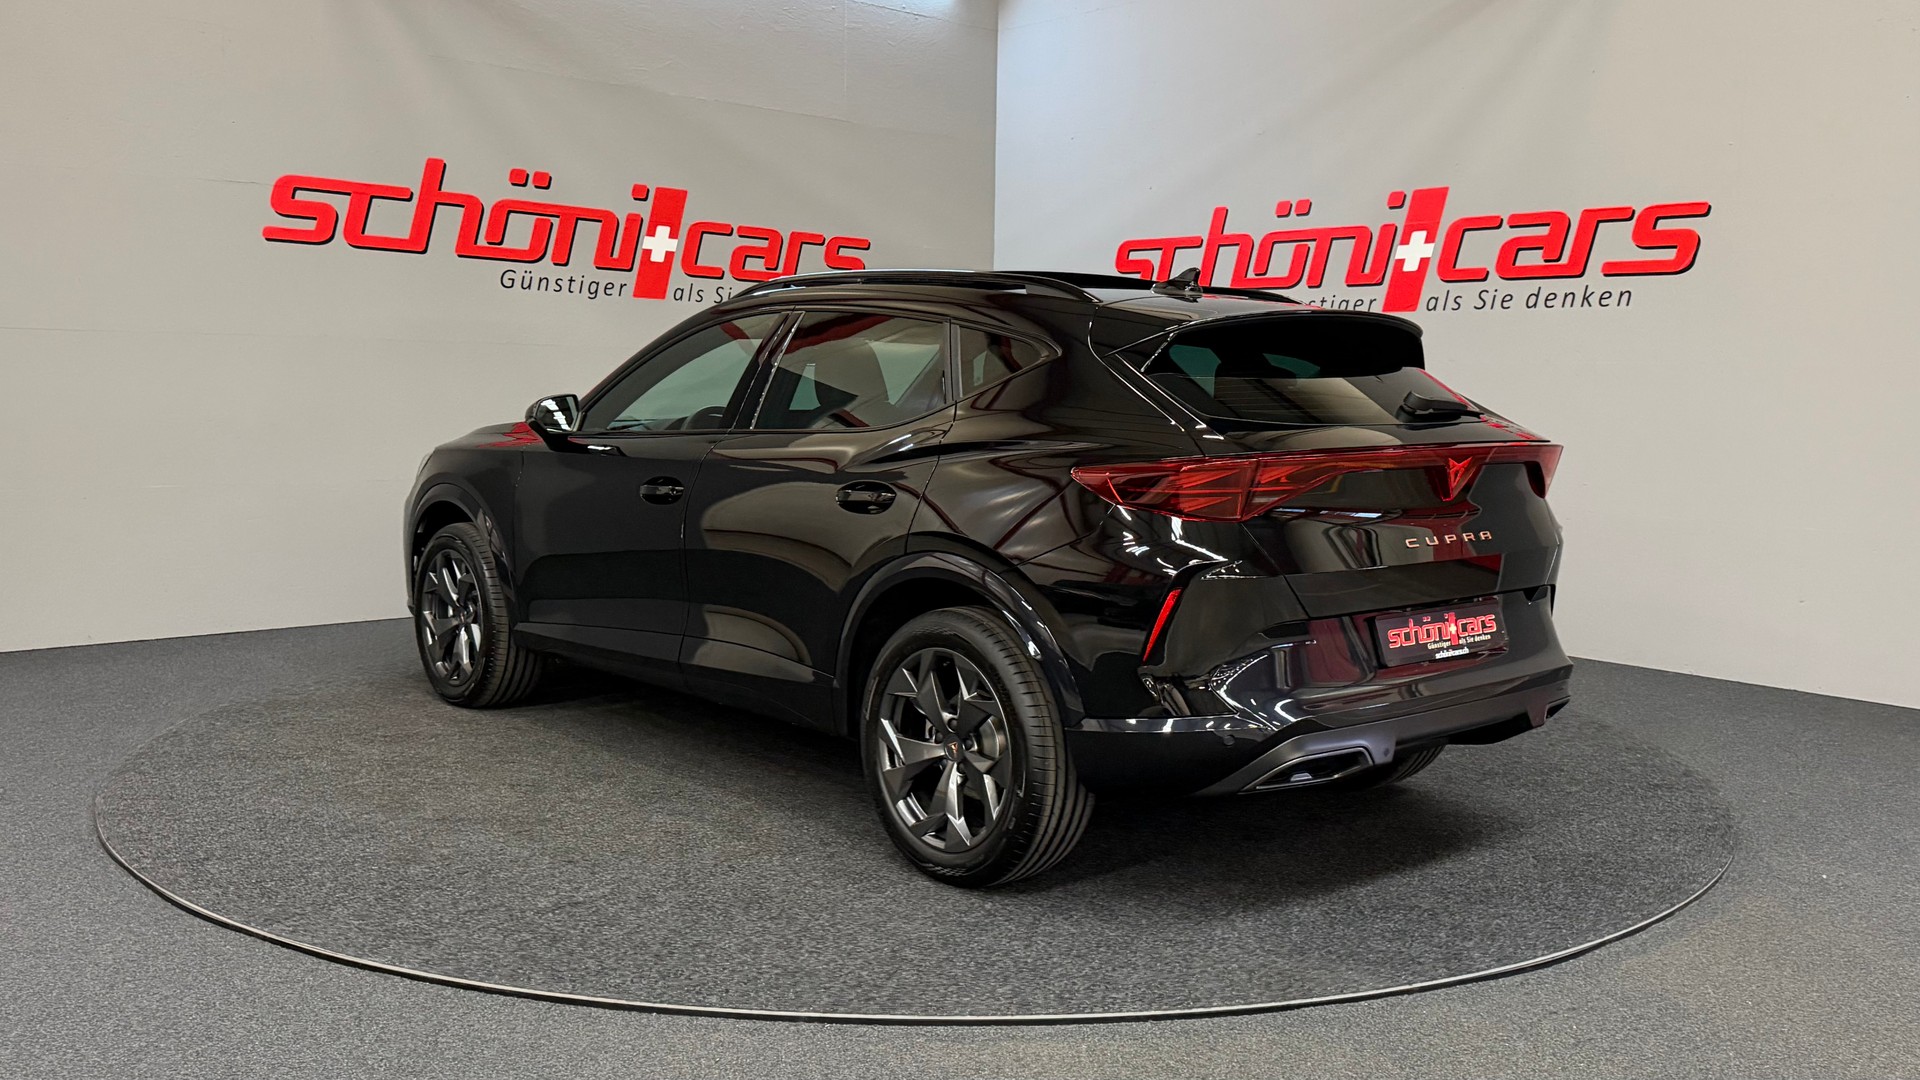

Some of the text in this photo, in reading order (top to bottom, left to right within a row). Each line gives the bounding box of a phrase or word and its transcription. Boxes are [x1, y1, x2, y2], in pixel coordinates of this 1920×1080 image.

[500, 269, 733, 304] Günstiger als Si
[1425, 290, 1463, 312] als
[1473, 289, 1515, 311] Sie
[1525, 284, 1633, 309] denken
[1405, 530, 1493, 548] CUPRA
